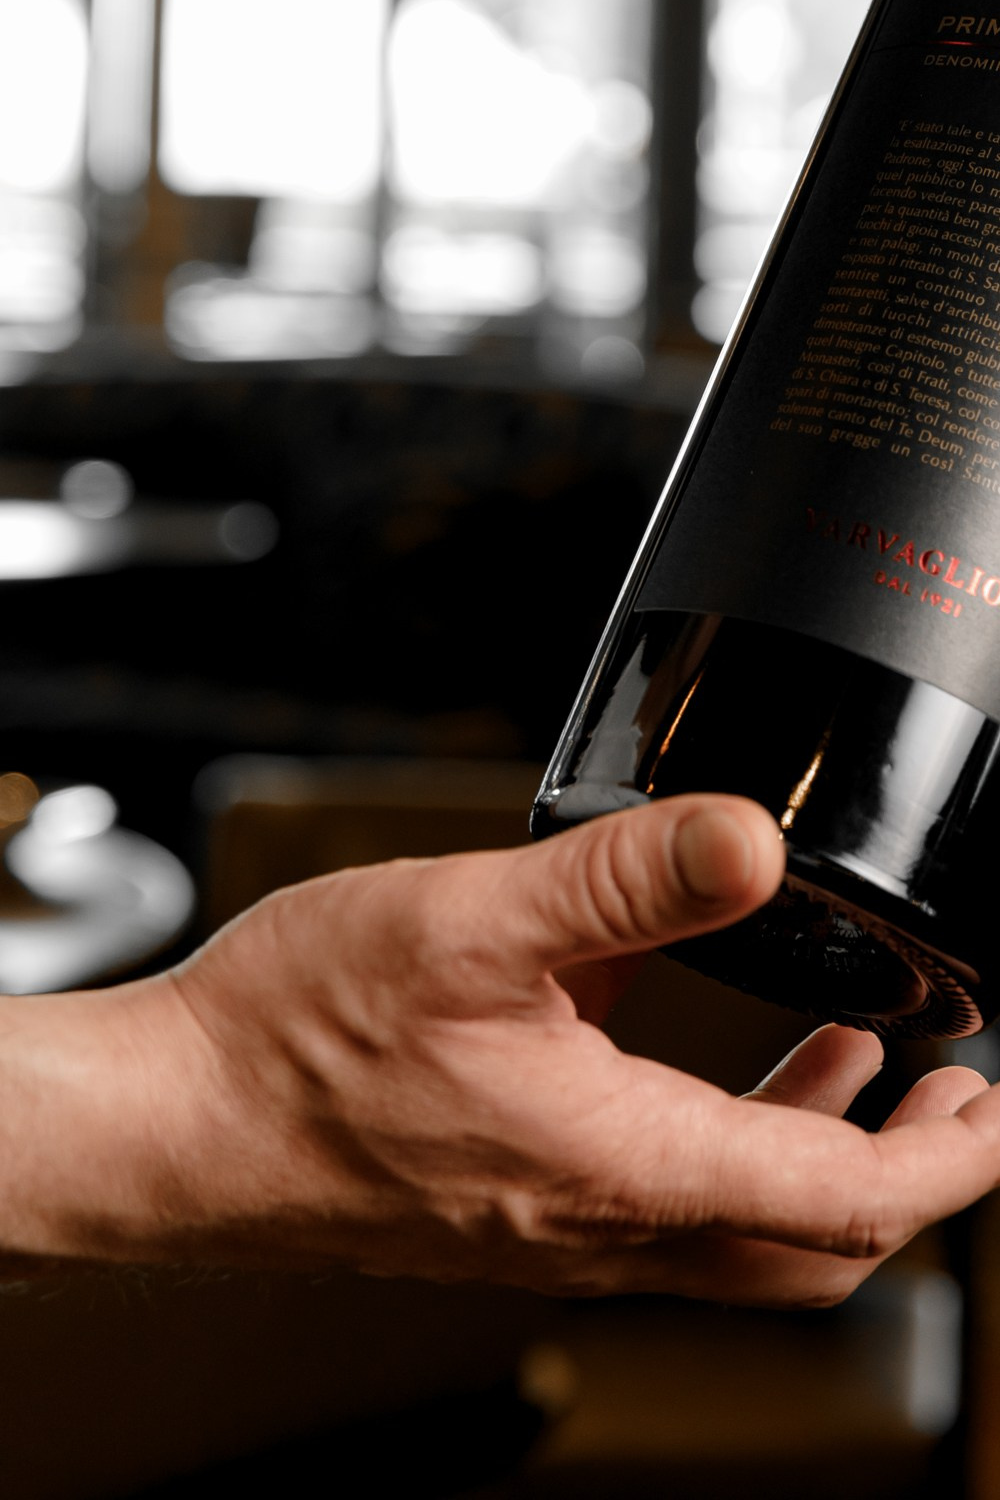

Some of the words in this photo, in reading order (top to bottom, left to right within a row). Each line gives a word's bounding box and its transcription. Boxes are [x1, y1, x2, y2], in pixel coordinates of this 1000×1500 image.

[947, 124, 972, 137] tale
[975, 131, 984, 140] e
[903, 137, 974, 155] esaltazione
[978, 147, 992, 159] al
[937, 160, 965, 174] oggi
[876, 169, 904, 183] quel
[905, 172, 965, 189] pubblico
[970, 179, 984, 193] lo
[869, 184, 917, 199] facendo
[922, 191, 966, 208] vedere
[898, 206, 949, 222] quantità
[954, 212, 980, 229] ben
[893, 220, 907, 232] di
[906, 224, 939, 238] gioia
[942, 231, 983, 248] accesi
[900, 259, 945, 275] ritratto
[948, 267, 964, 280] di
[929, 244, 943, 256] in
[947, 250, 985, 268] molti
[834, 269, 880, 282] sentire
[888, 275, 906, 286] un
[916, 280, 985, 306] continuo
[895, 293, 929, 309] salve
[820, 302, 851, 313] sorti
[858, 303, 873, 316] di
[882, 306, 932, 328] fuochi
[890, 327, 905, 340] di
[907, 334, 963, 356] estremo
[836, 336, 881, 354] Insigne
[885, 344, 948, 373] Capitolo,
[954, 366, 964, 376] e
[867, 362, 895, 375] così
[898, 366, 914, 380] di
[917, 370, 951, 394] Frati,
[957, 387, 998, 408] come
[862, 380, 871, 388] e
[874, 379, 889, 393] di
[909, 386, 953, 414] Teresa,
[958, 408, 981, 422] col
[828, 410, 866, 425] canto
[870, 416, 894, 431] del
[899, 422, 914, 438] Te
[918, 429, 966, 459] Deum,
[971, 453, 999, 469] per
[916, 412, 940, 426] col
[942, 421, 1000, 450] rendere
[828, 429, 881, 450] gregge
[890, 444, 911, 457] un
[921, 454, 954, 472] così
[874, 570, 911, 596] DAL
[920, 588, 962, 618] 1921
